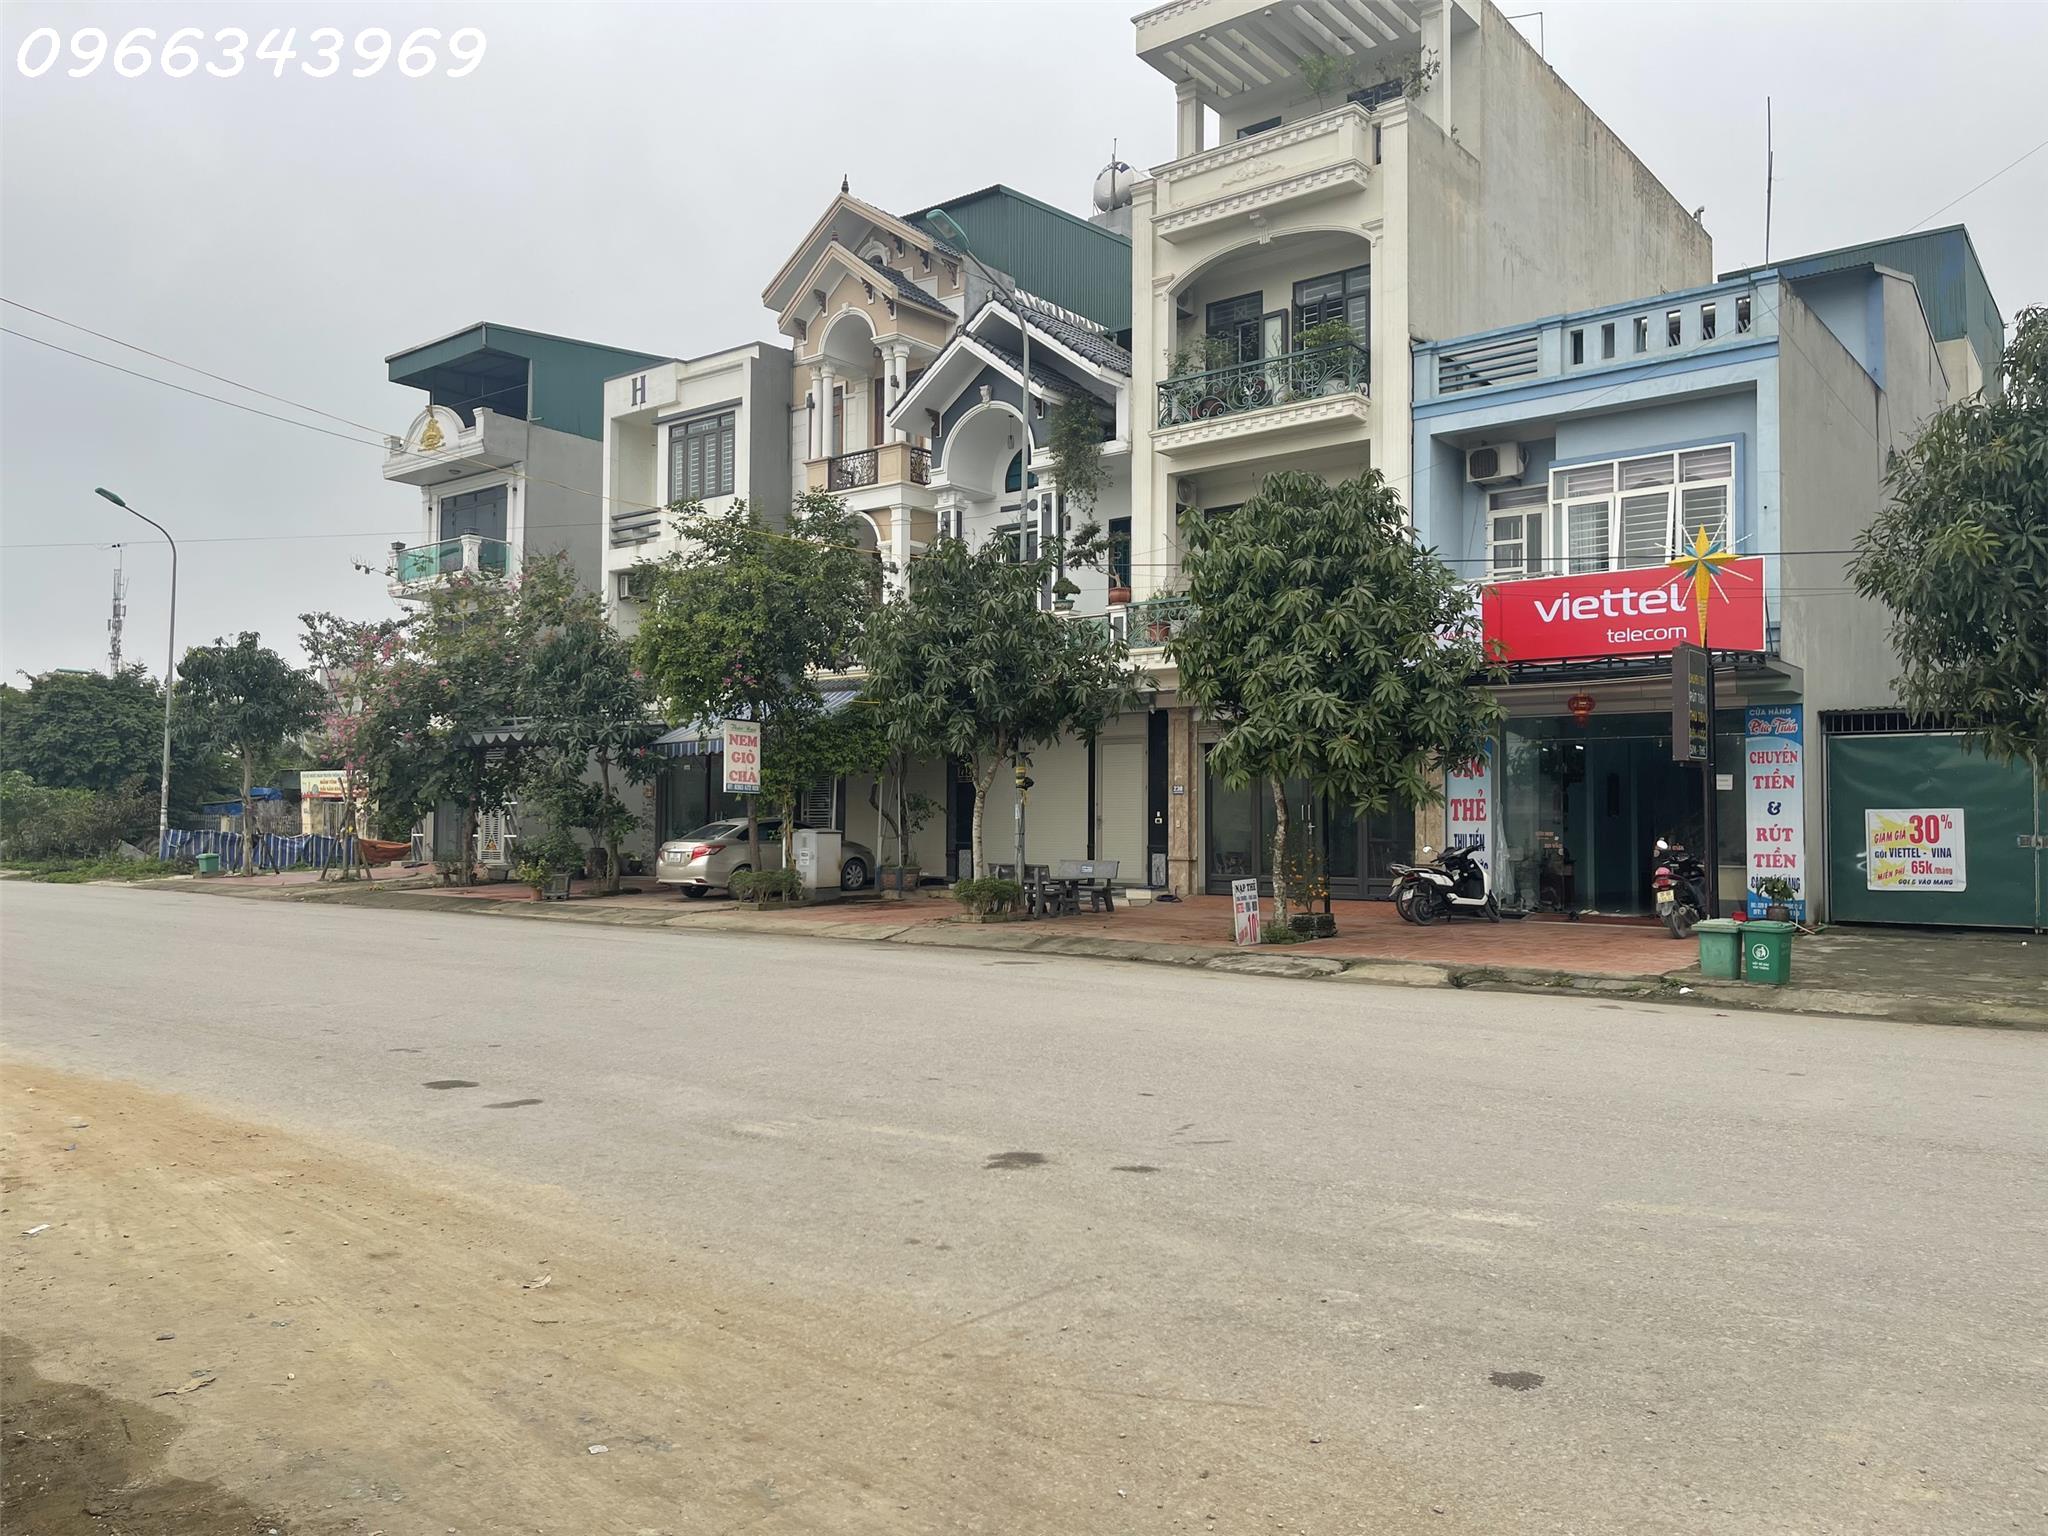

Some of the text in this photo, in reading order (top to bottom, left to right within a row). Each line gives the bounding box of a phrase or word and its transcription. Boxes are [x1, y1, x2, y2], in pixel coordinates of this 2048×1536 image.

[631, 375, 646, 407] H
[1533, 583, 1687, 623] viettel
[1607, 626, 1687, 643] telecom
[1768, 706, 1792, 716] HÀNG
[729, 733, 758, 747] NEM
[731, 750, 756, 764] GIÒ
[1749, 743, 1798, 764] CHUYỂN
[1752, 768, 1796, 790] TIỀN
[1450, 788, 1487, 821] THẺ
[1767, 801, 1782, 816] &
[1755, 824, 1794, 842] RÚT
[1753, 847, 1797, 869] TIỀN
[1888, 848, 1921, 858] VIETTEL
[1931, 848, 1952, 858] VINA
[1911, 860, 1933, 875] 65k
